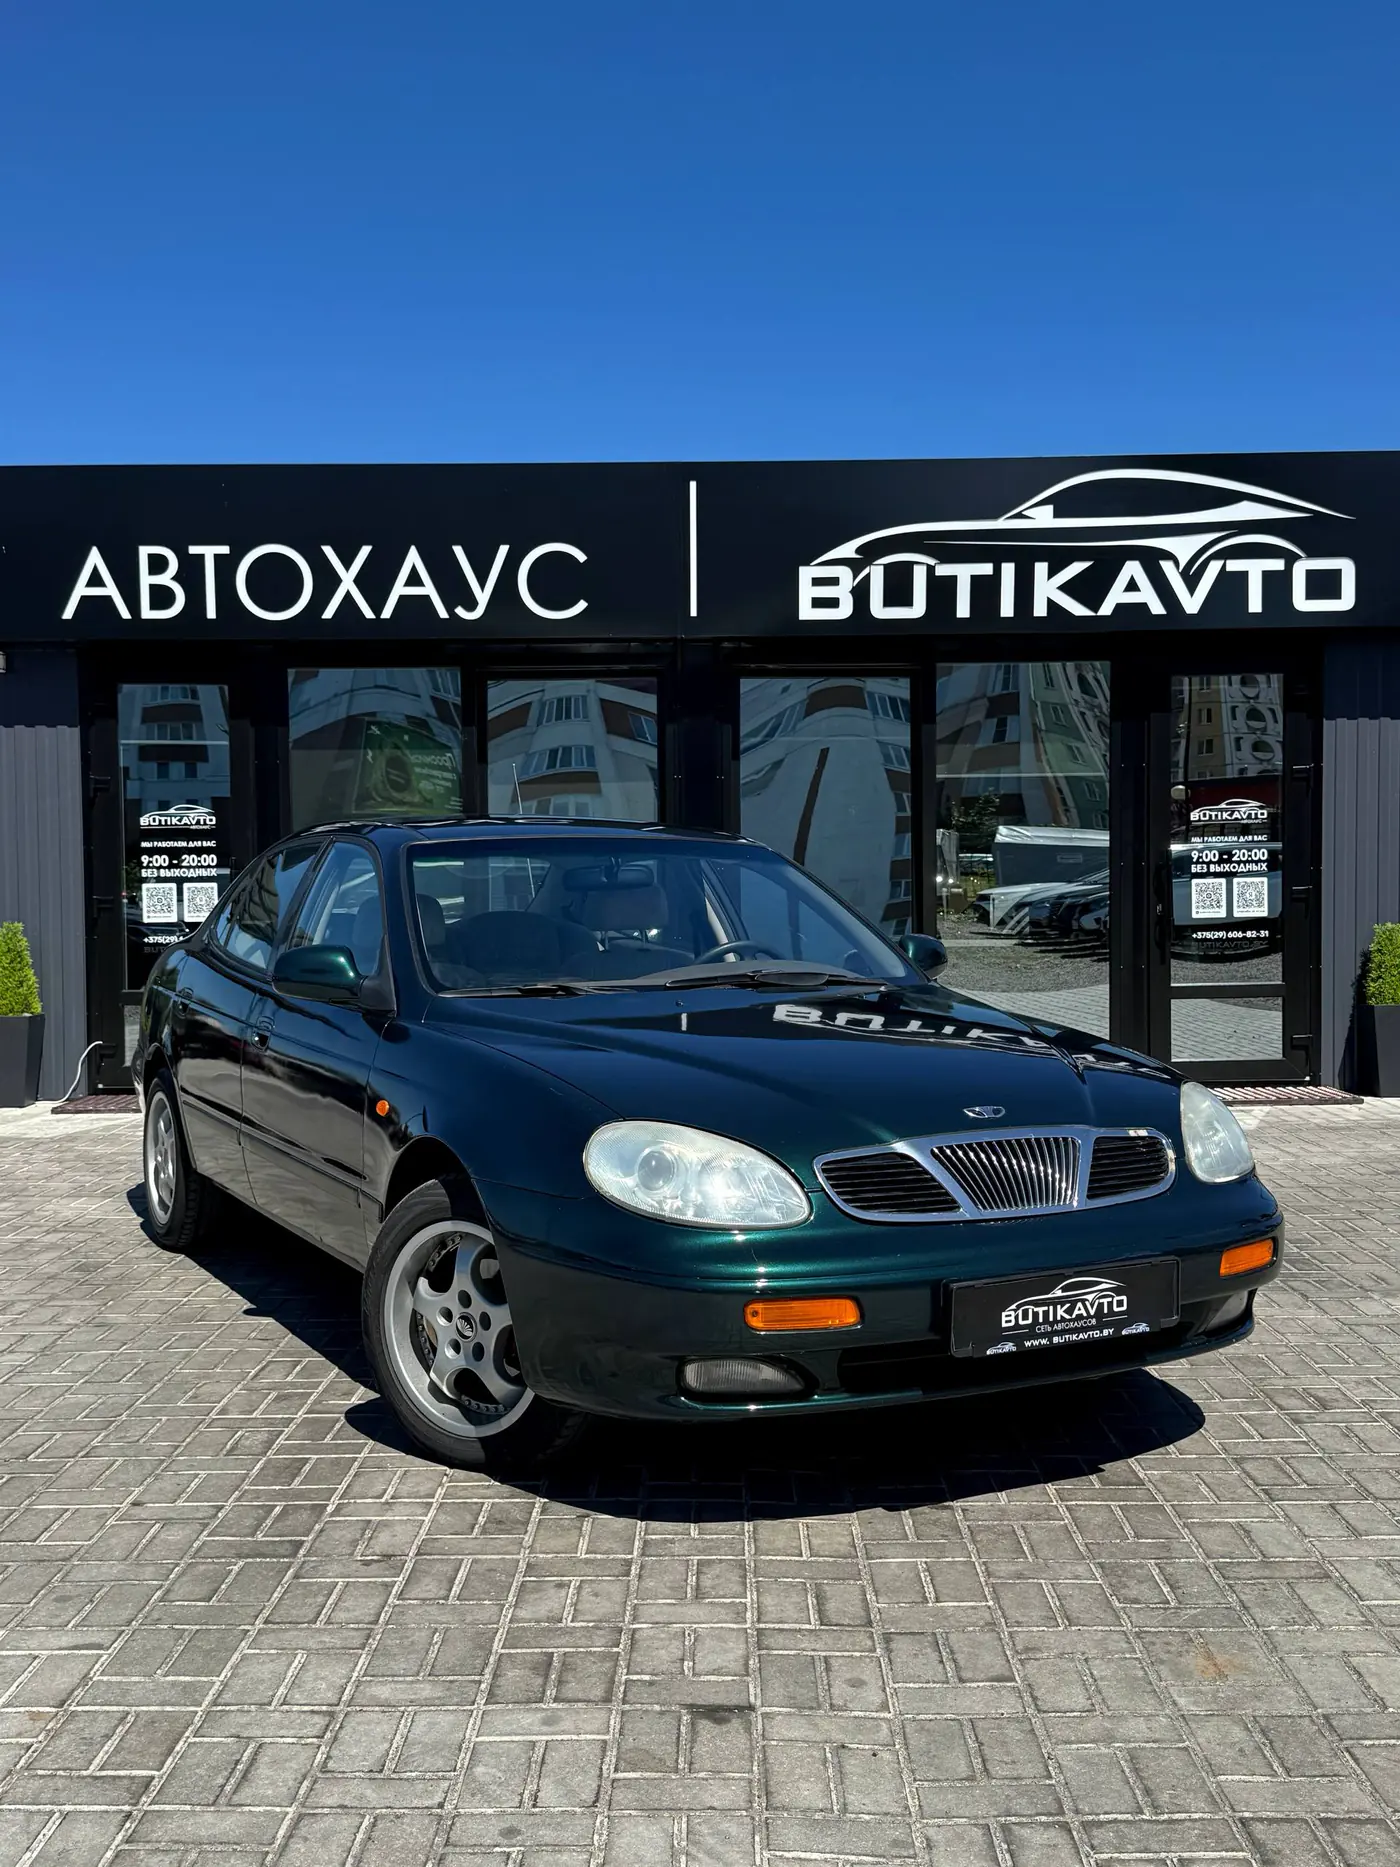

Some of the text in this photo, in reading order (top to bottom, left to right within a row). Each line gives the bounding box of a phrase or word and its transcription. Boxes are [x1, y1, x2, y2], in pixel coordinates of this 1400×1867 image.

[61, 542, 589, 621] АВТОХАУС
[798, 556, 1356, 621] BUTIKAVTO
[140, 816, 216, 825] BUTIKAVTO
[1190, 810, 1267, 820] BUTIKAVTO
[1239, 834, 1253, 842] ДЛЯ
[141, 855, 169, 867] 9:00
[181, 854, 217, 867] 20:00
[1191, 850, 1219, 862] 9:00
[1232, 848, 1268, 861] 20:00
[141, 867, 217, 878] БЕЗ ВЫХОДНЫХ
[1191, 862, 1268, 873] БЕЗ ВЫХОДНЫХ
[1228, 930, 1269, 938] 606-82-31
[1001, 1295, 1128, 1327] BUTIKAVTO
[1035, 1318, 1097, 1333] СЕТЬ АВТОХАУСОВ
[1024, 1328, 1115, 1348] WWW. BUTIKAVTO.BY
